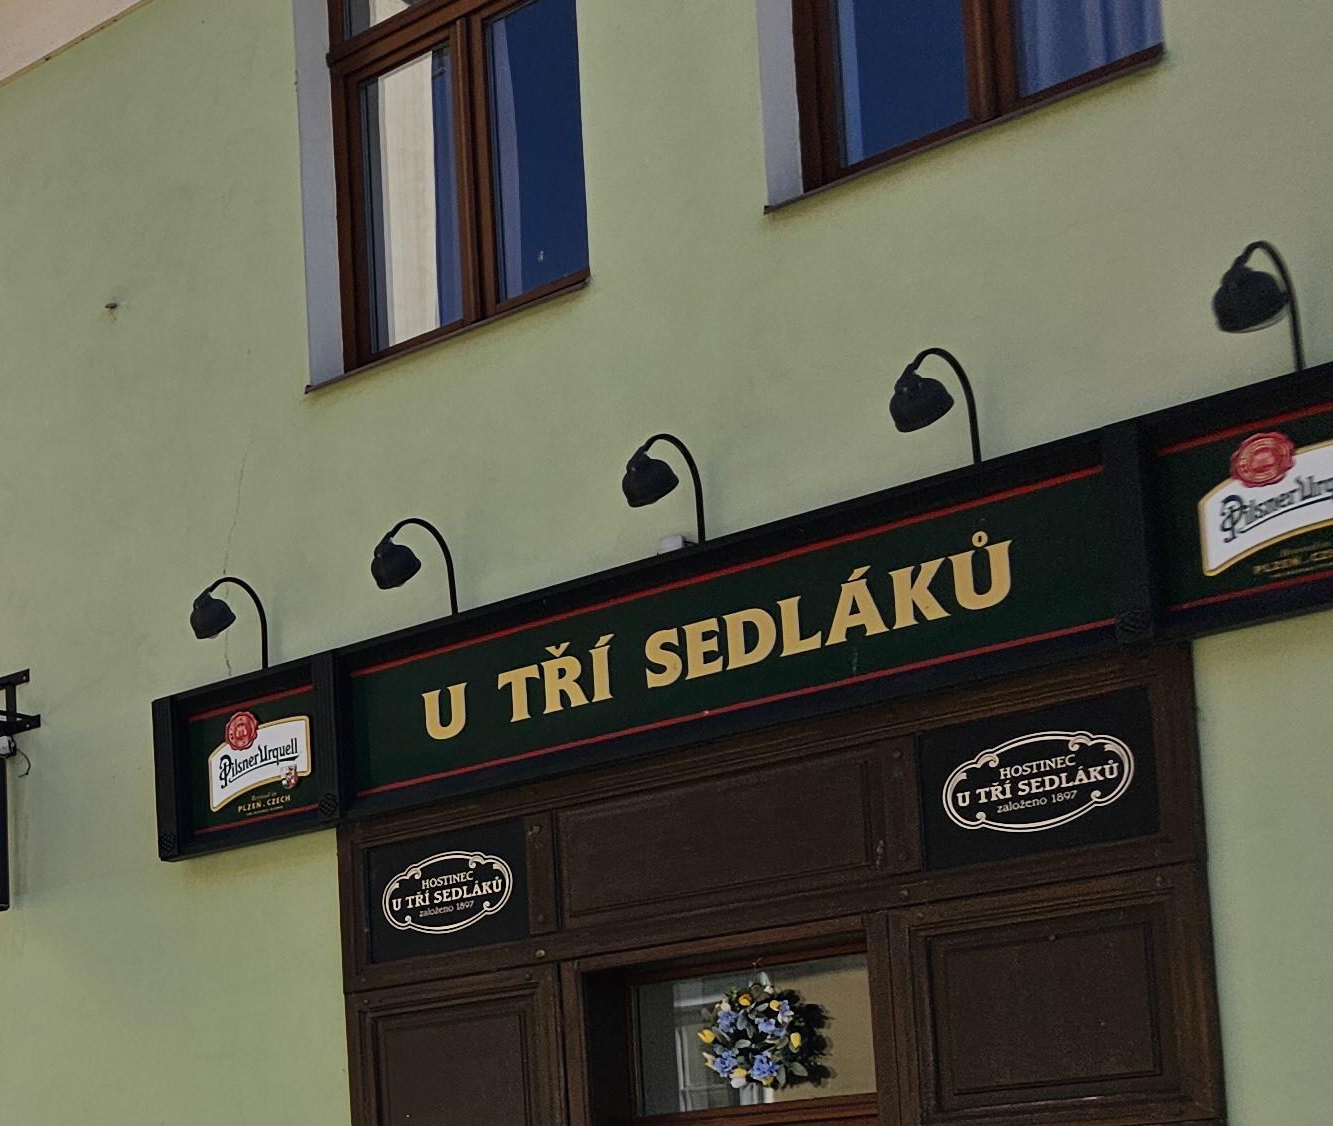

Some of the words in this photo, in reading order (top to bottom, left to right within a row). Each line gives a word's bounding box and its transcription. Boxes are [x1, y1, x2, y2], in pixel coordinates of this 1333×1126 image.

[421, 682, 468, 740] U
[498, 634, 615, 723] TŘÍ
[645, 531, 1013, 689] SEDLÁKŮ
[219, 752, 259, 789] Pilsner
[258, 738, 298, 765] Urquell
[999, 754, 1076, 779] HOSTINEC
[956, 792, 970, 807] U
[976, 780, 1012, 803] TŘÍ
[1018, 760, 1120, 796] SEDLÁKŮ
[996, 796, 1048, 814] založeno
[1051, 790, 1078, 804] 1897
[392, 899, 402, 911] U
[405, 890, 430, 908] TŘÍ
[433, 876, 503, 904] SEDLÁKŮ
[421, 871, 474, 890] HOSTINEC
